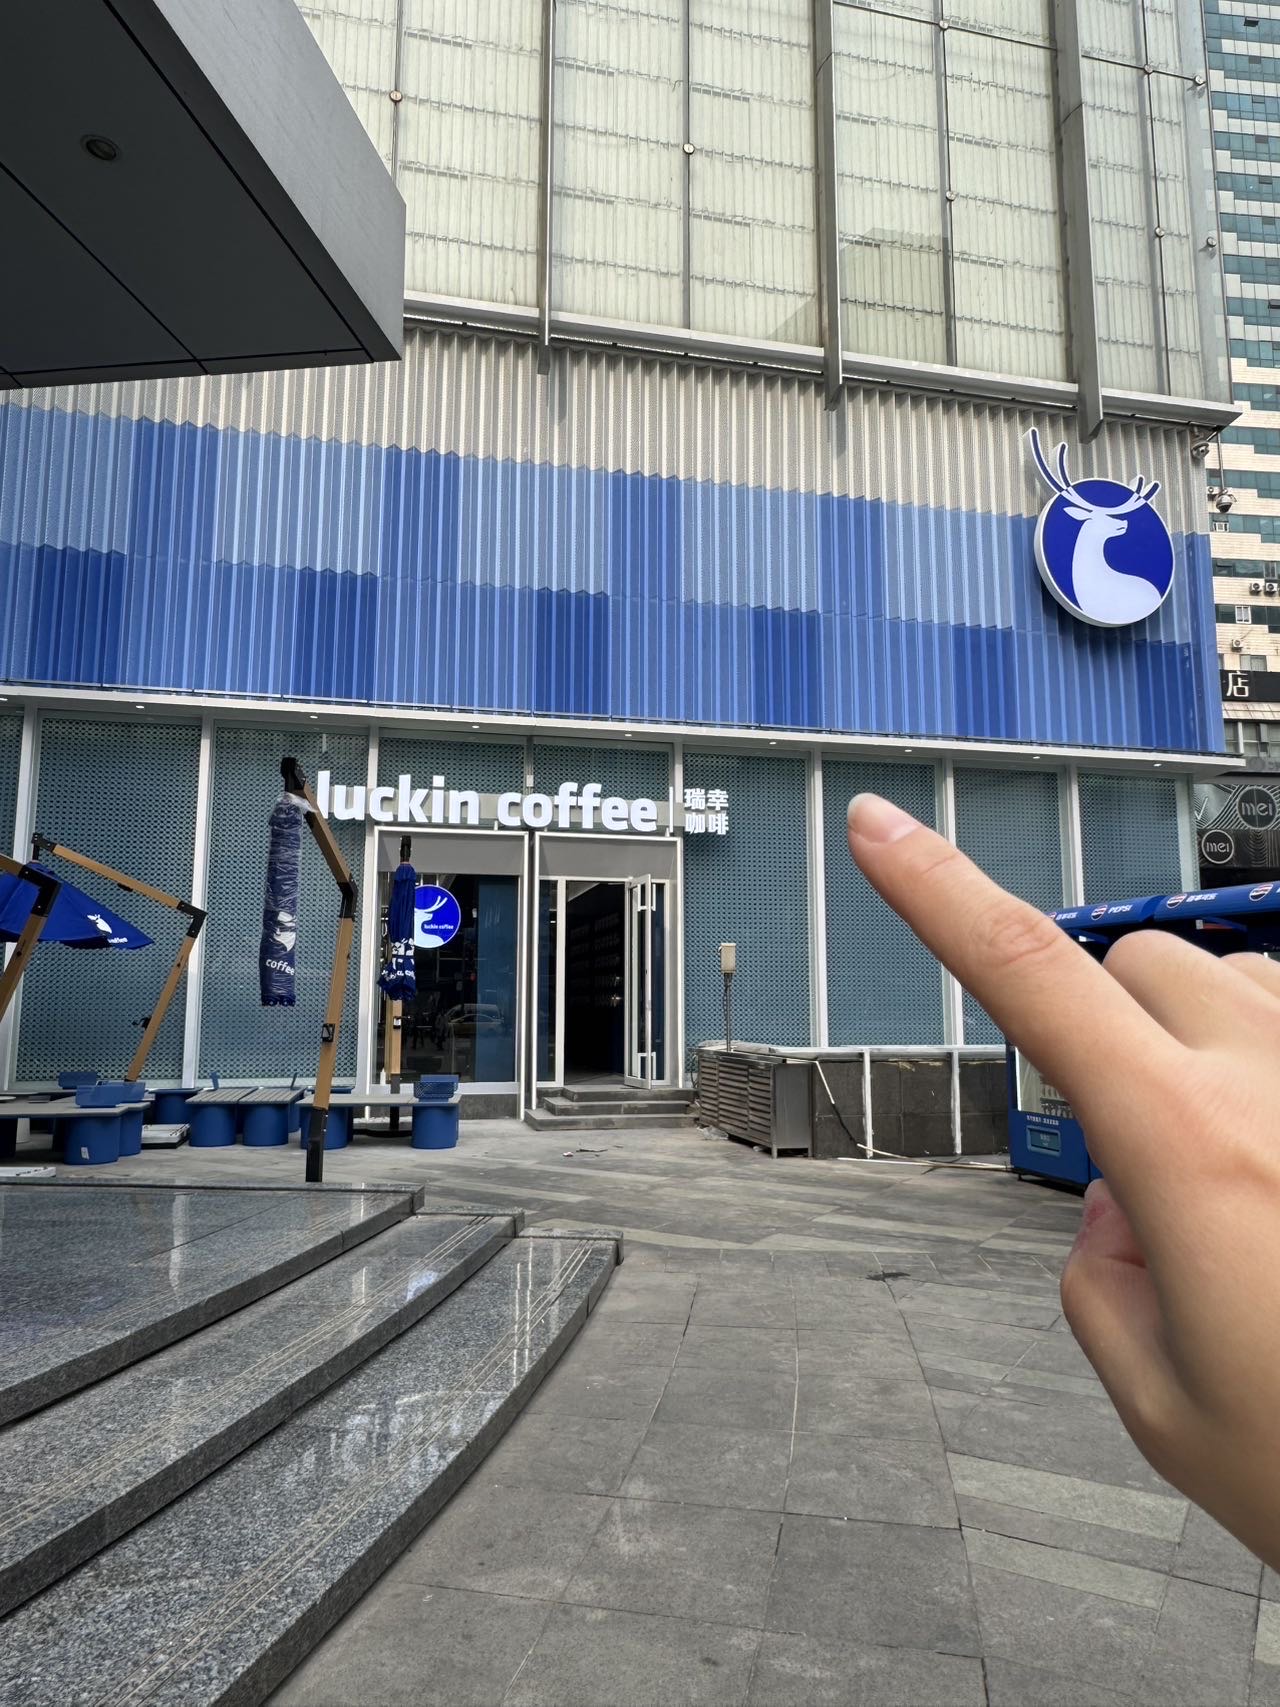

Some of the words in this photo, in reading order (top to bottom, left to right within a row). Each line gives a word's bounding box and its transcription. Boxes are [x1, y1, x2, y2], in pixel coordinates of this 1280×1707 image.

[1226, 670, 1250, 698] 店
[317, 770, 480, 825] luckin
[498, 781, 658, 832] coffee
[684, 788, 729, 811] 瑞幸
[1241, 801, 1273, 816] mei
[684, 812, 730, 835] 咖啡
[1206, 842, 1230, 853] mei
[265, 958, 296, 976] coffee
